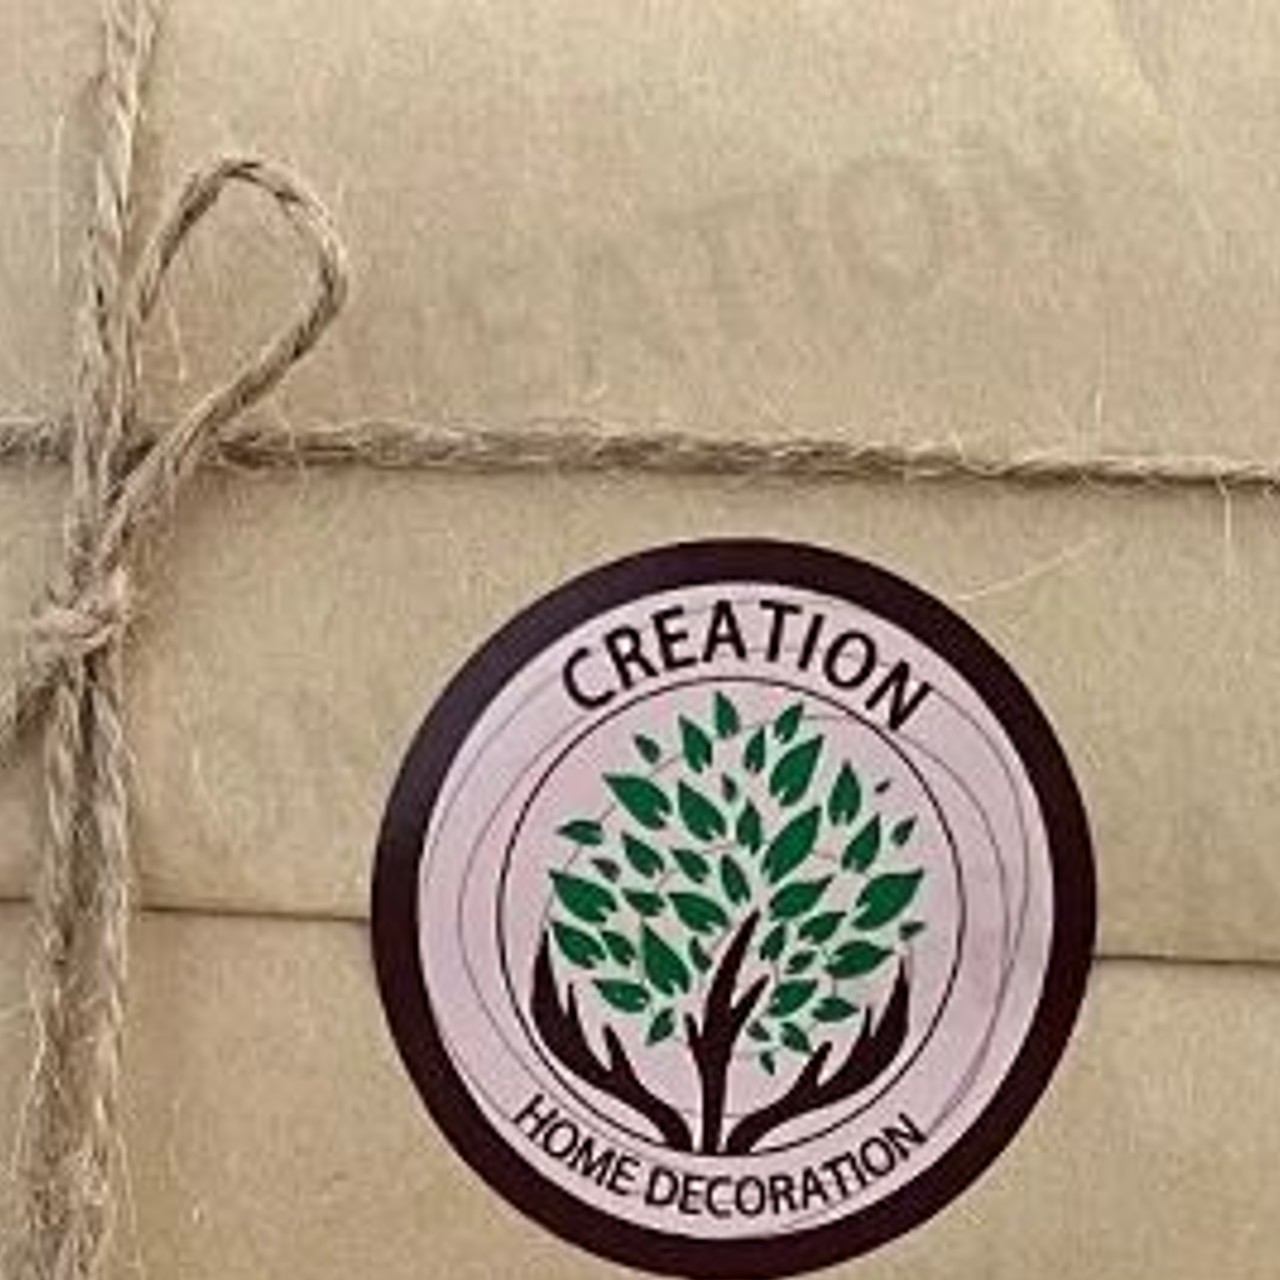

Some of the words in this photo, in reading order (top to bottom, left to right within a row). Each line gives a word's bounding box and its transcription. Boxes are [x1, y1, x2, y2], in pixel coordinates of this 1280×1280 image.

[561, 598, 936, 733] CREATION
[511, 1093, 641, 1196] HOME
[643, 1111, 929, 1218] DECORATION
